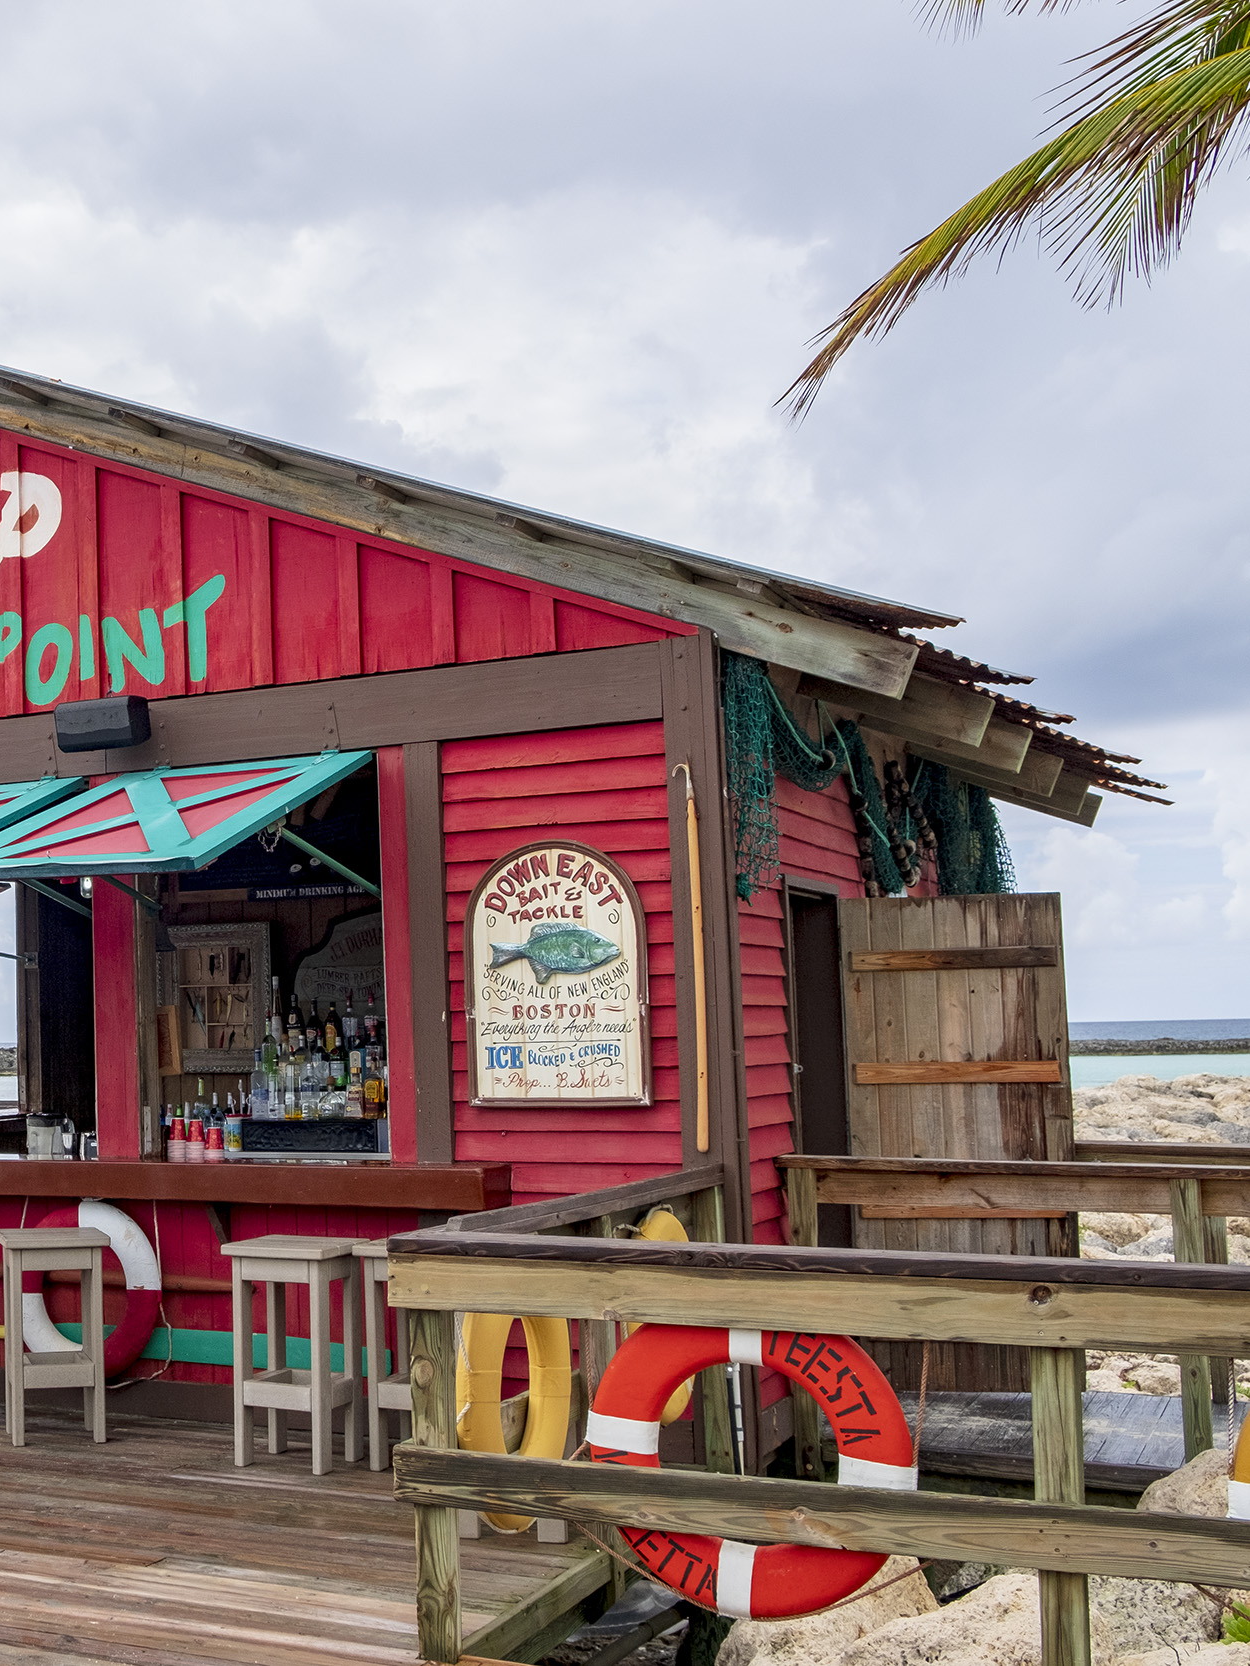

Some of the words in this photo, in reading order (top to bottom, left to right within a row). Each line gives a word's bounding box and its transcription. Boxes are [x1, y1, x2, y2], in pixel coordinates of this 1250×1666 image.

[299, 886, 344, 897] DRINKING
[484, 853, 550, 915] DOWN
[557, 853, 624, 907] EAST
[515, 881, 562, 908] BAIT
[565, 887, 583, 902] &
[507, 905, 584, 924] TACKLE
[317, 968, 350, 985] LUMBER
[527, 985, 546, 999] ALL
[549, 986, 562, 1000] OF
[567, 982, 588, 998] NEW
[512, 1003, 596, 1020] BOSTON
[542, 1021, 559, 1034] the
[485, 1045, 524, 1070] ICE
[528, 1050, 566, 1067] BLOCKED
[570, 1051, 576, 1062] &
[578, 1043, 621, 1059] CRUSHED
